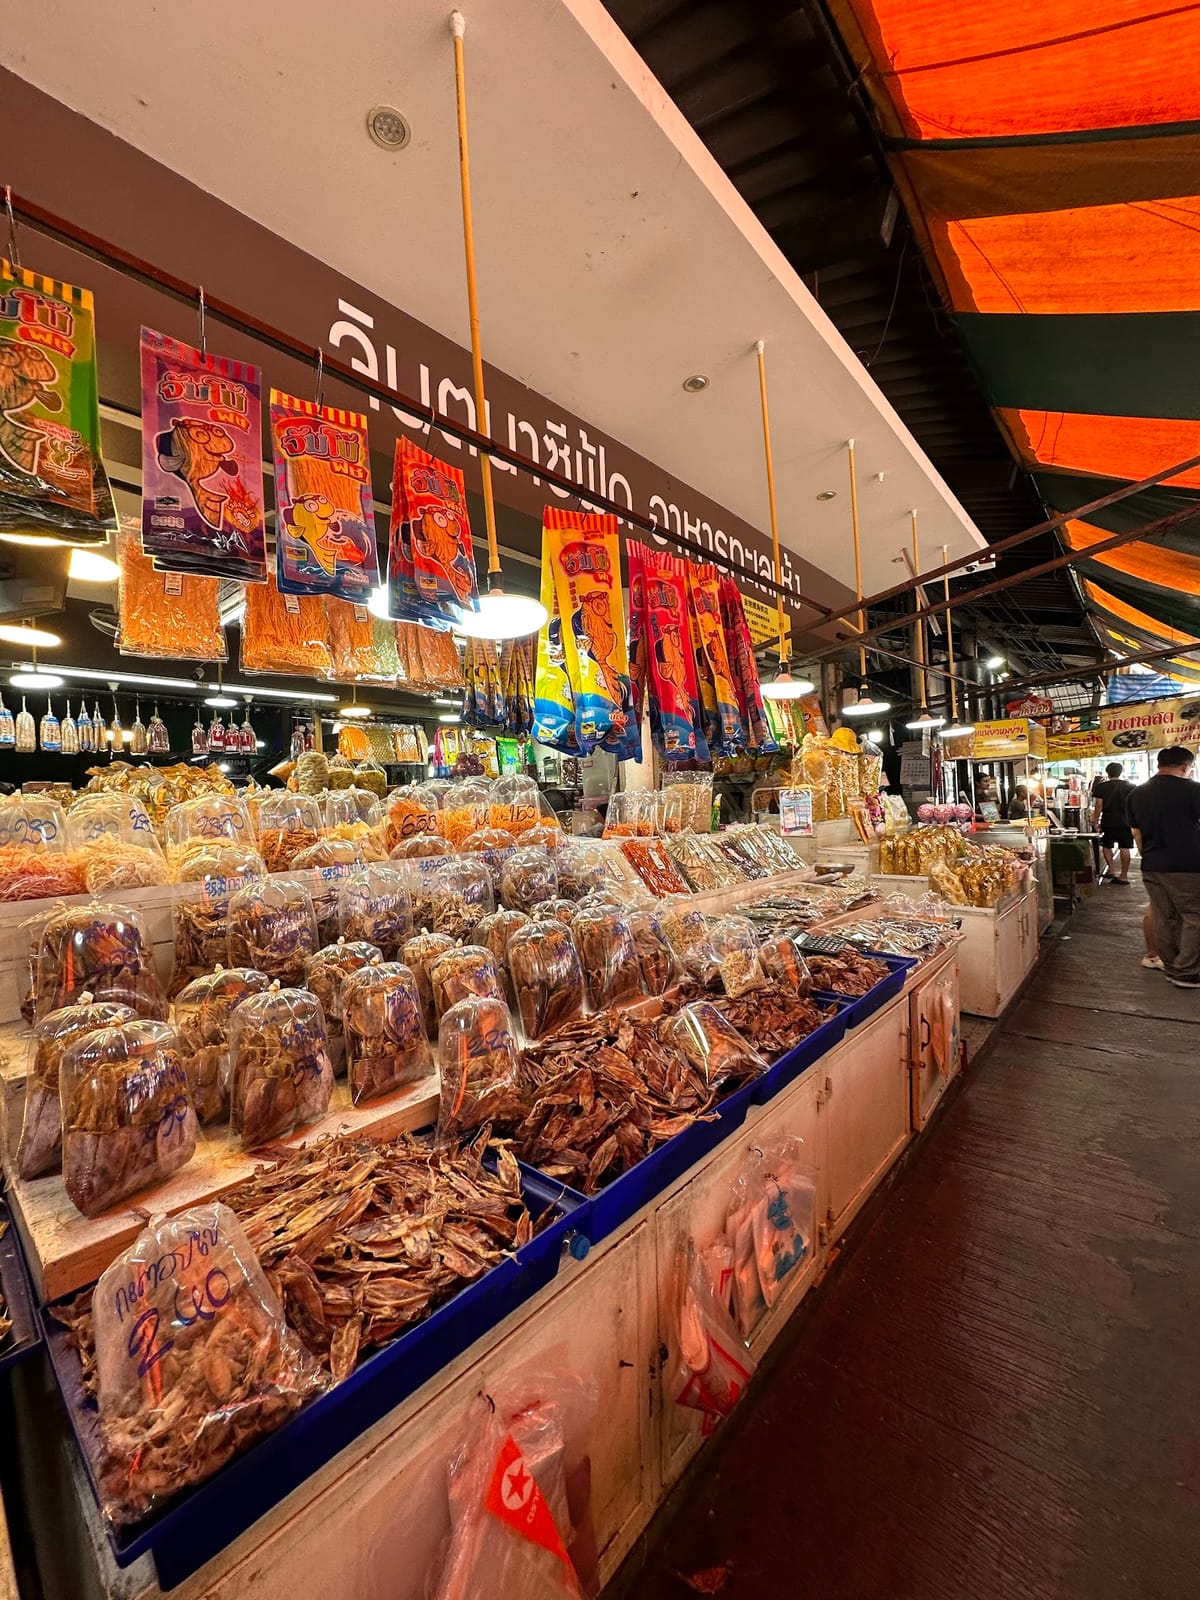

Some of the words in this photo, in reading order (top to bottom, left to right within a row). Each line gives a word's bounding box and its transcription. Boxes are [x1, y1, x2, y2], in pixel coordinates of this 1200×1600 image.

[159, 371, 248, 414] จัมโบ้
[281, 424, 360, 464] จัมโบ้
[15, 818, 57, 844] 280
